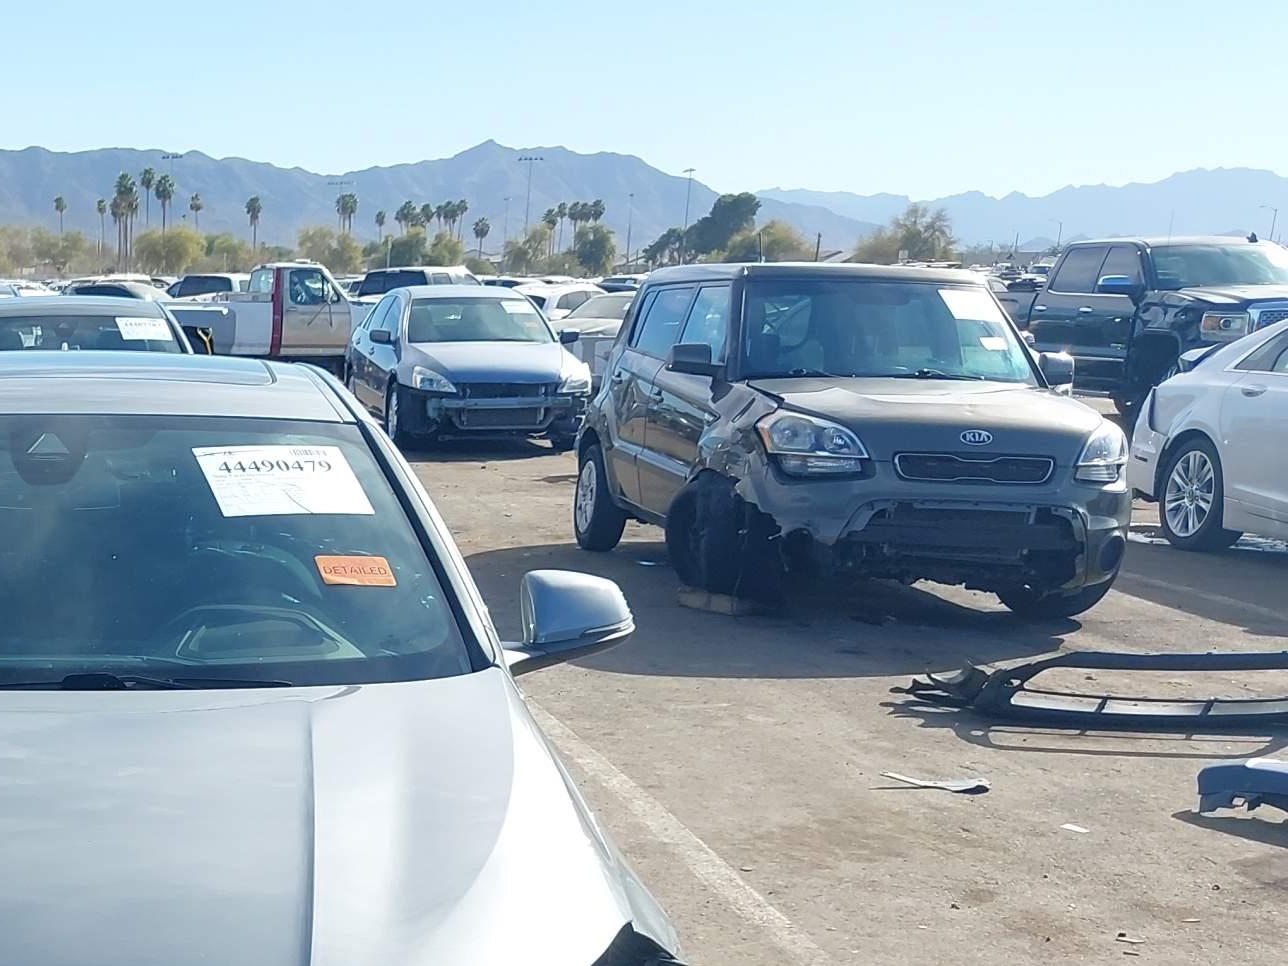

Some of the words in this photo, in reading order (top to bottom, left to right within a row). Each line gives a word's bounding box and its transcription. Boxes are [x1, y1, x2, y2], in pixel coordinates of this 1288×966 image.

[964, 431, 989, 442] KIA
[218, 459, 332, 474] 44490479
[322, 565, 387, 576] DETAILED
